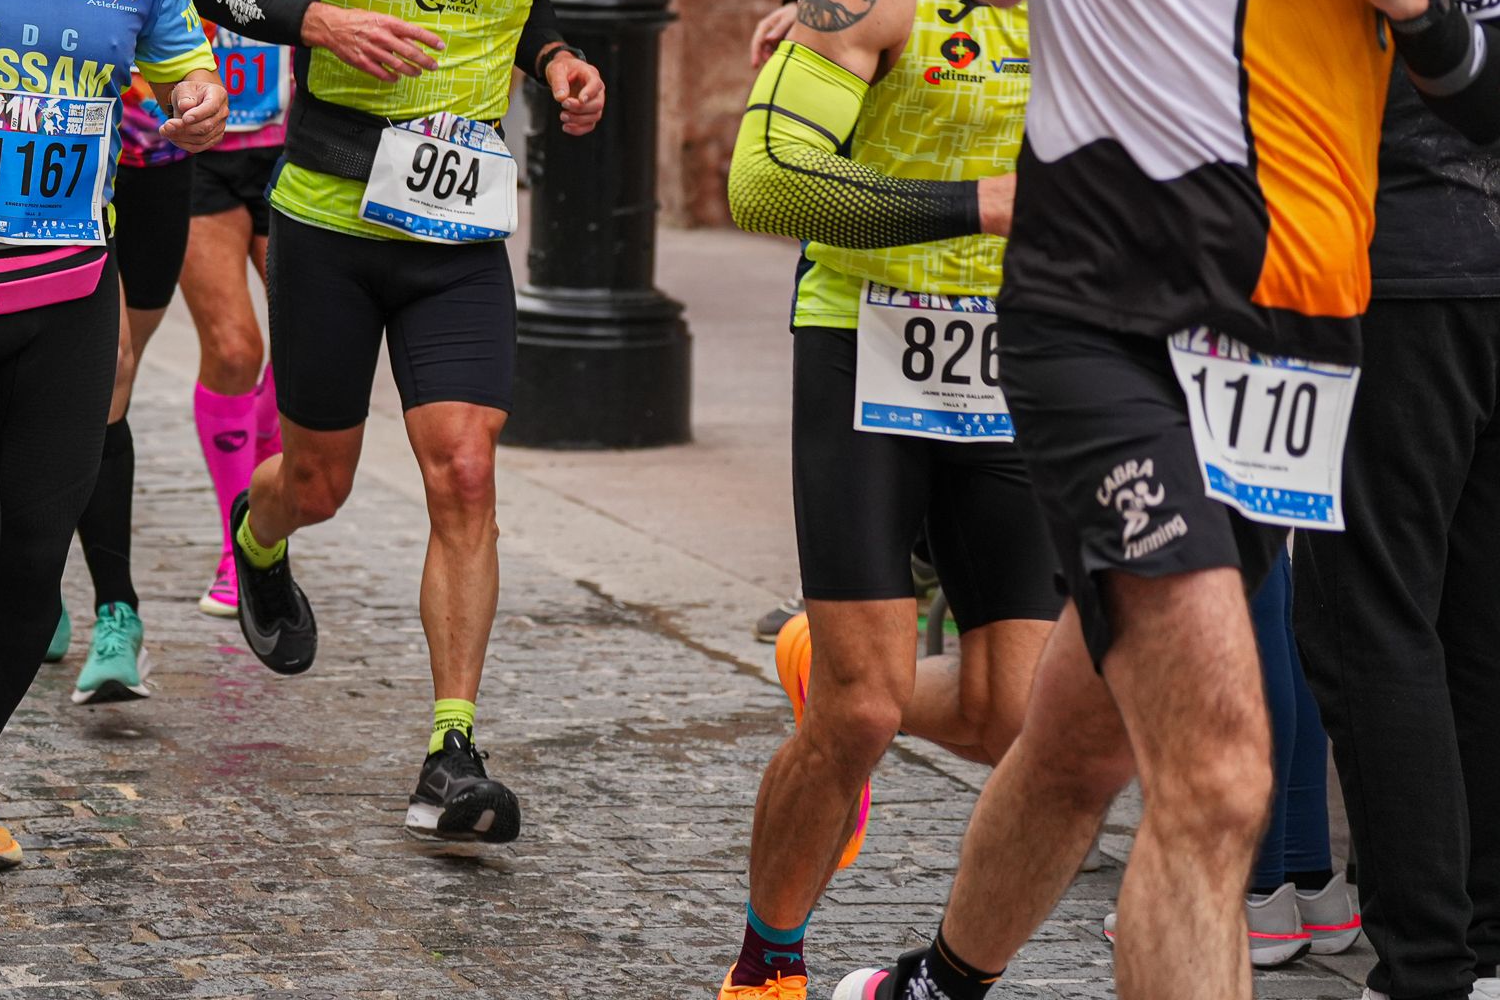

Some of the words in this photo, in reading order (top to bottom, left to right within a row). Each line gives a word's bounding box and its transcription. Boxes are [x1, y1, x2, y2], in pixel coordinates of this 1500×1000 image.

[446, 4, 476, 15] METAL
[22, 23, 39, 47] D
[62, 28, 79, 52] C
[213, 52, 266, 96] 61
[924, 66, 986, 85] Codimar
[406, 142, 480, 207] 964
[1191, 366, 1318, 459] 1110
[1096, 458, 1155, 507] CABRA
[1124, 513, 1189, 560] running
